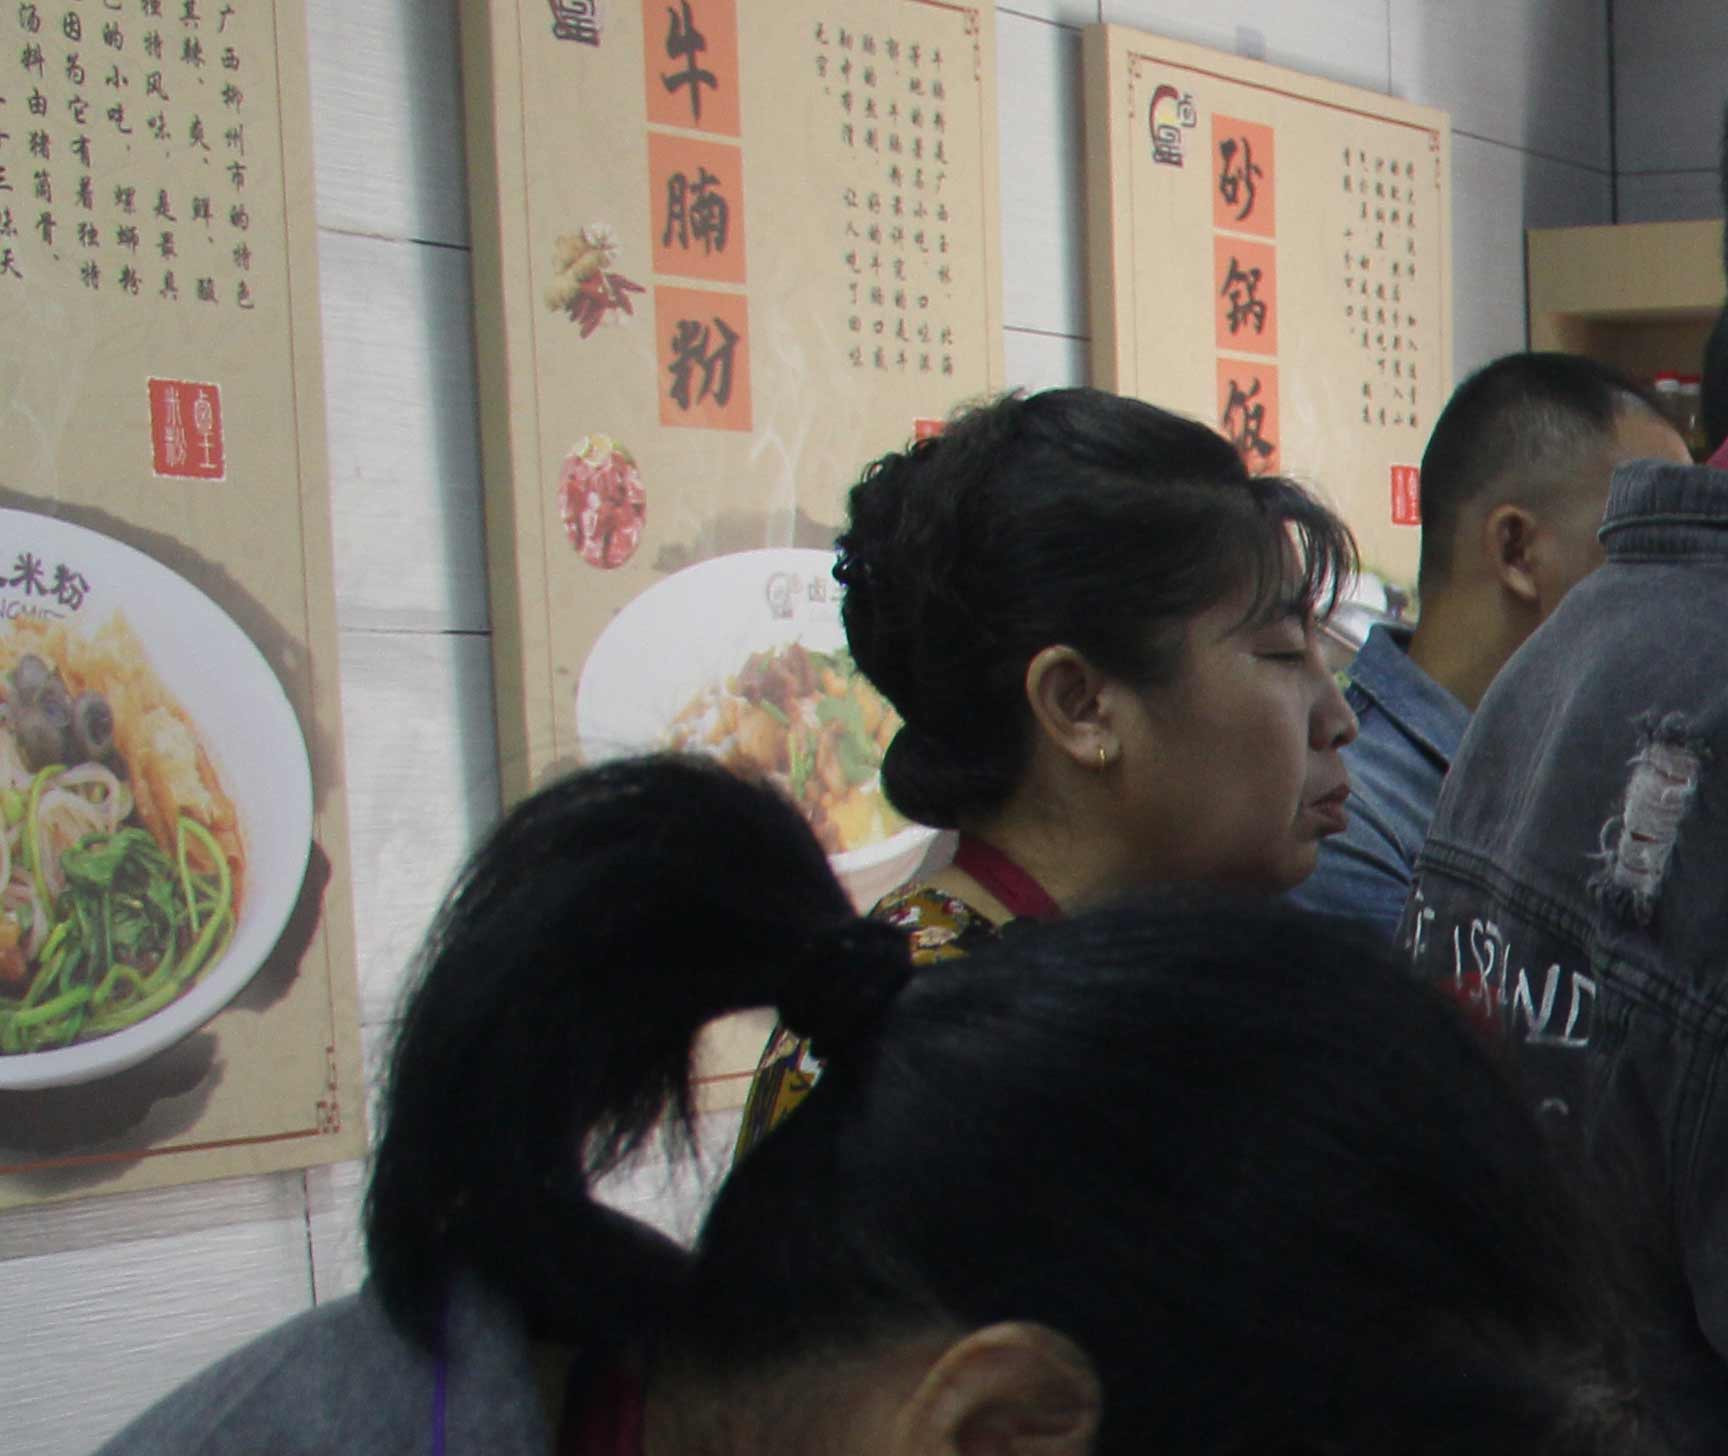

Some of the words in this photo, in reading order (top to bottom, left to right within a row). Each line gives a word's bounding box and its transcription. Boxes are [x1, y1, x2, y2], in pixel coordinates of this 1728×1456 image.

[660, 0, 740, 411] 牛腩粉
[0, 551, 91, 612] 米粉
